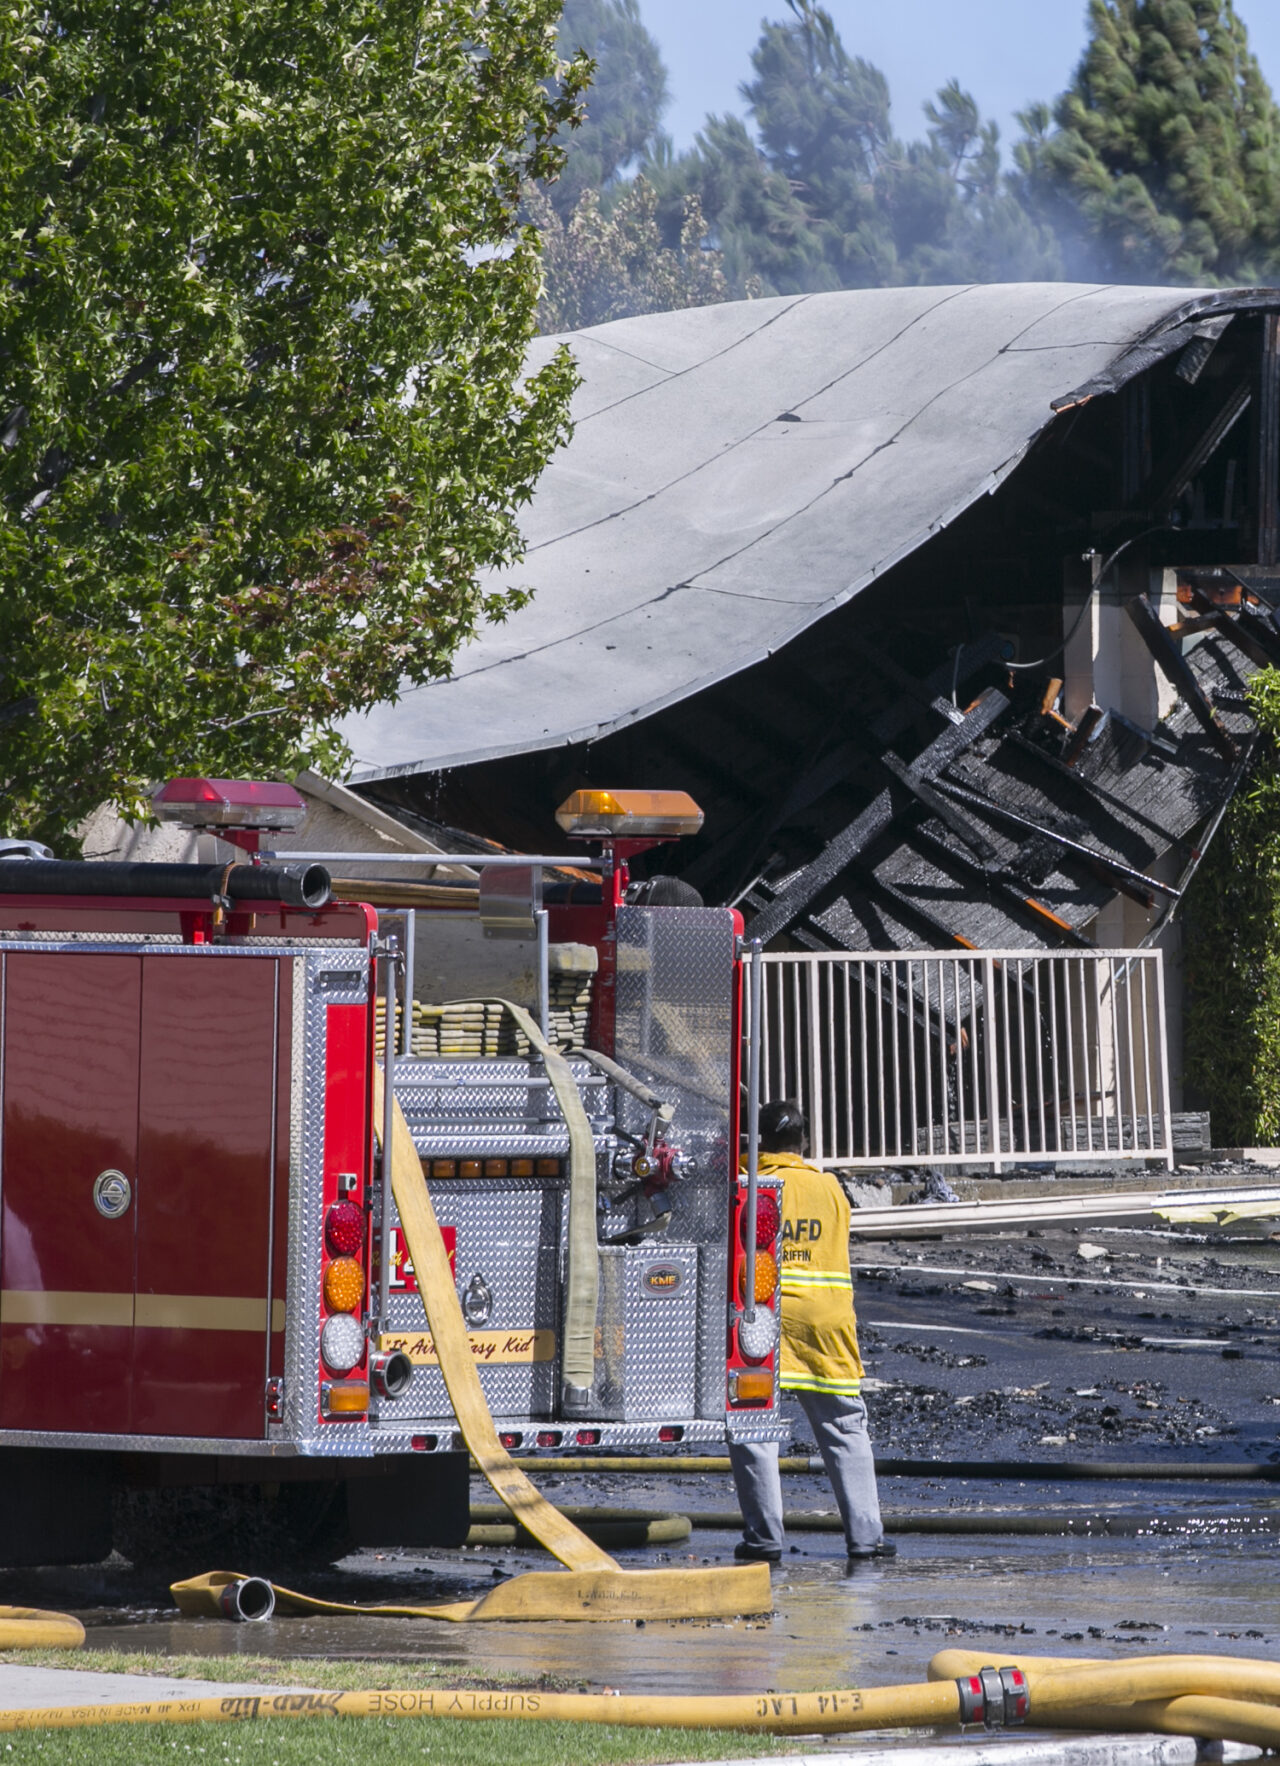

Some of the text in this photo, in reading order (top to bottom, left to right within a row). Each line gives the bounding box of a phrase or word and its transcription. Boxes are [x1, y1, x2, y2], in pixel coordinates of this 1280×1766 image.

[782, 1219, 823, 1241] AFD
[782, 1250, 812, 1262] RIFFIN
[409, 1338, 438, 1355] Ain
[469, 1338, 496, 1360] asy
[368, 1694, 434, 1712] HOSE
[447, 1695, 541, 1712] SUPPLY
